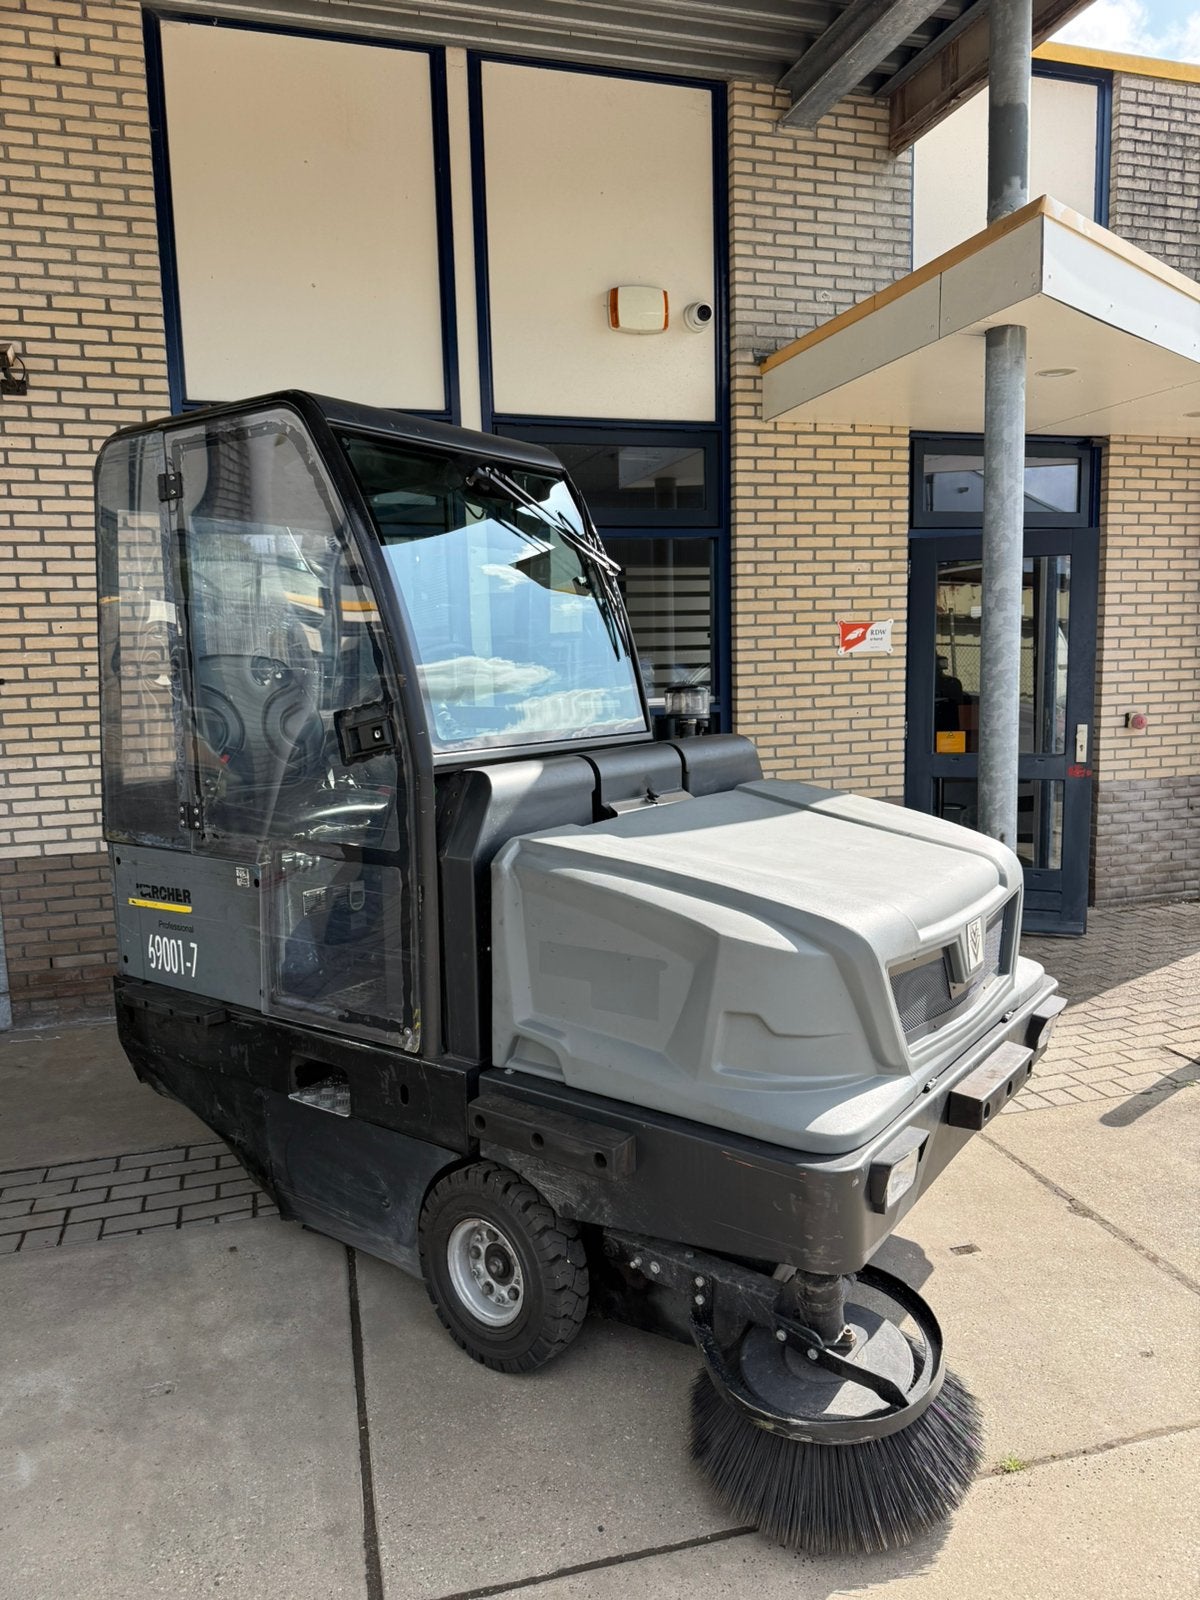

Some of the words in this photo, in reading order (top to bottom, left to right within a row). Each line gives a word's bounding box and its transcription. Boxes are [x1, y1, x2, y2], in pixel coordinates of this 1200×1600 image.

[135, 882, 192, 904] RCHER
[158, 920, 194, 933] Professional
[148, 934, 198, 978] 69001-7
